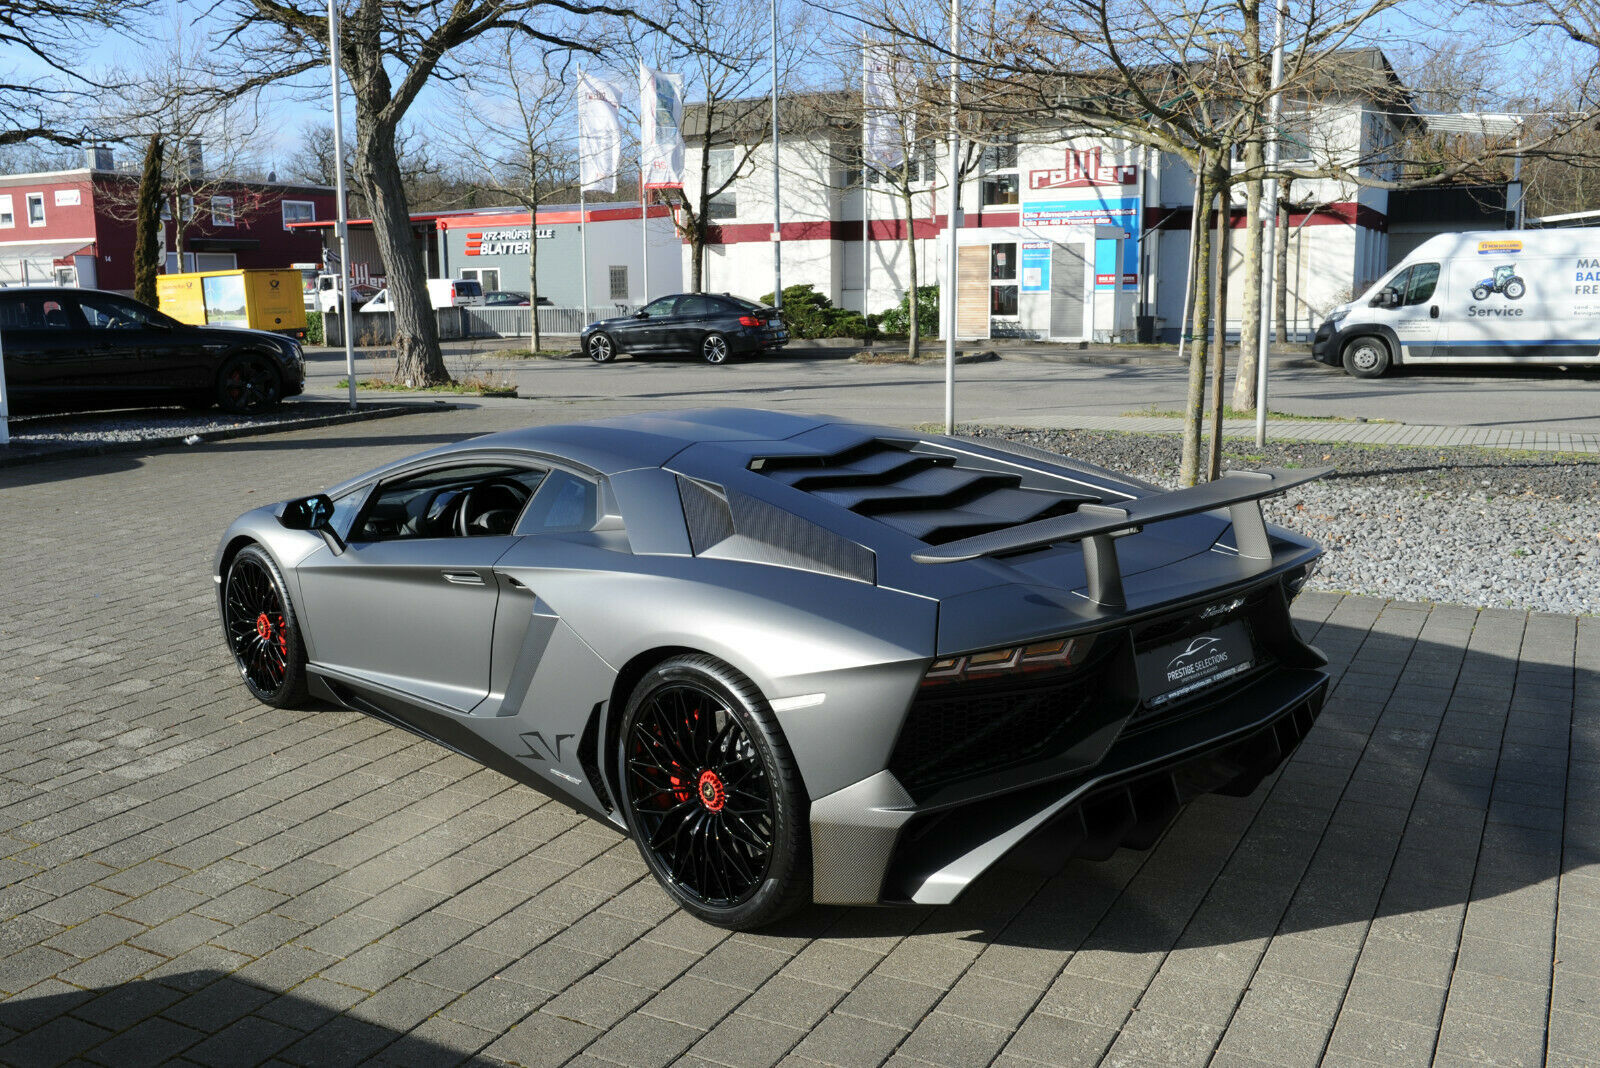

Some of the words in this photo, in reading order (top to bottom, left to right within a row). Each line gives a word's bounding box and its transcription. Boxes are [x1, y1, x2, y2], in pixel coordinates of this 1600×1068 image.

[1031, 148, 1135, 188] rottler
[482, 229, 553, 240] KFZ-PRÜFSTLLE
[480, 241, 531, 255] BLATTER
[1468, 305, 1524, 317] Service
[1167, 664, 1195, 682] PRESTIGE
[1195, 652, 1228, 670] SELECTIONS
